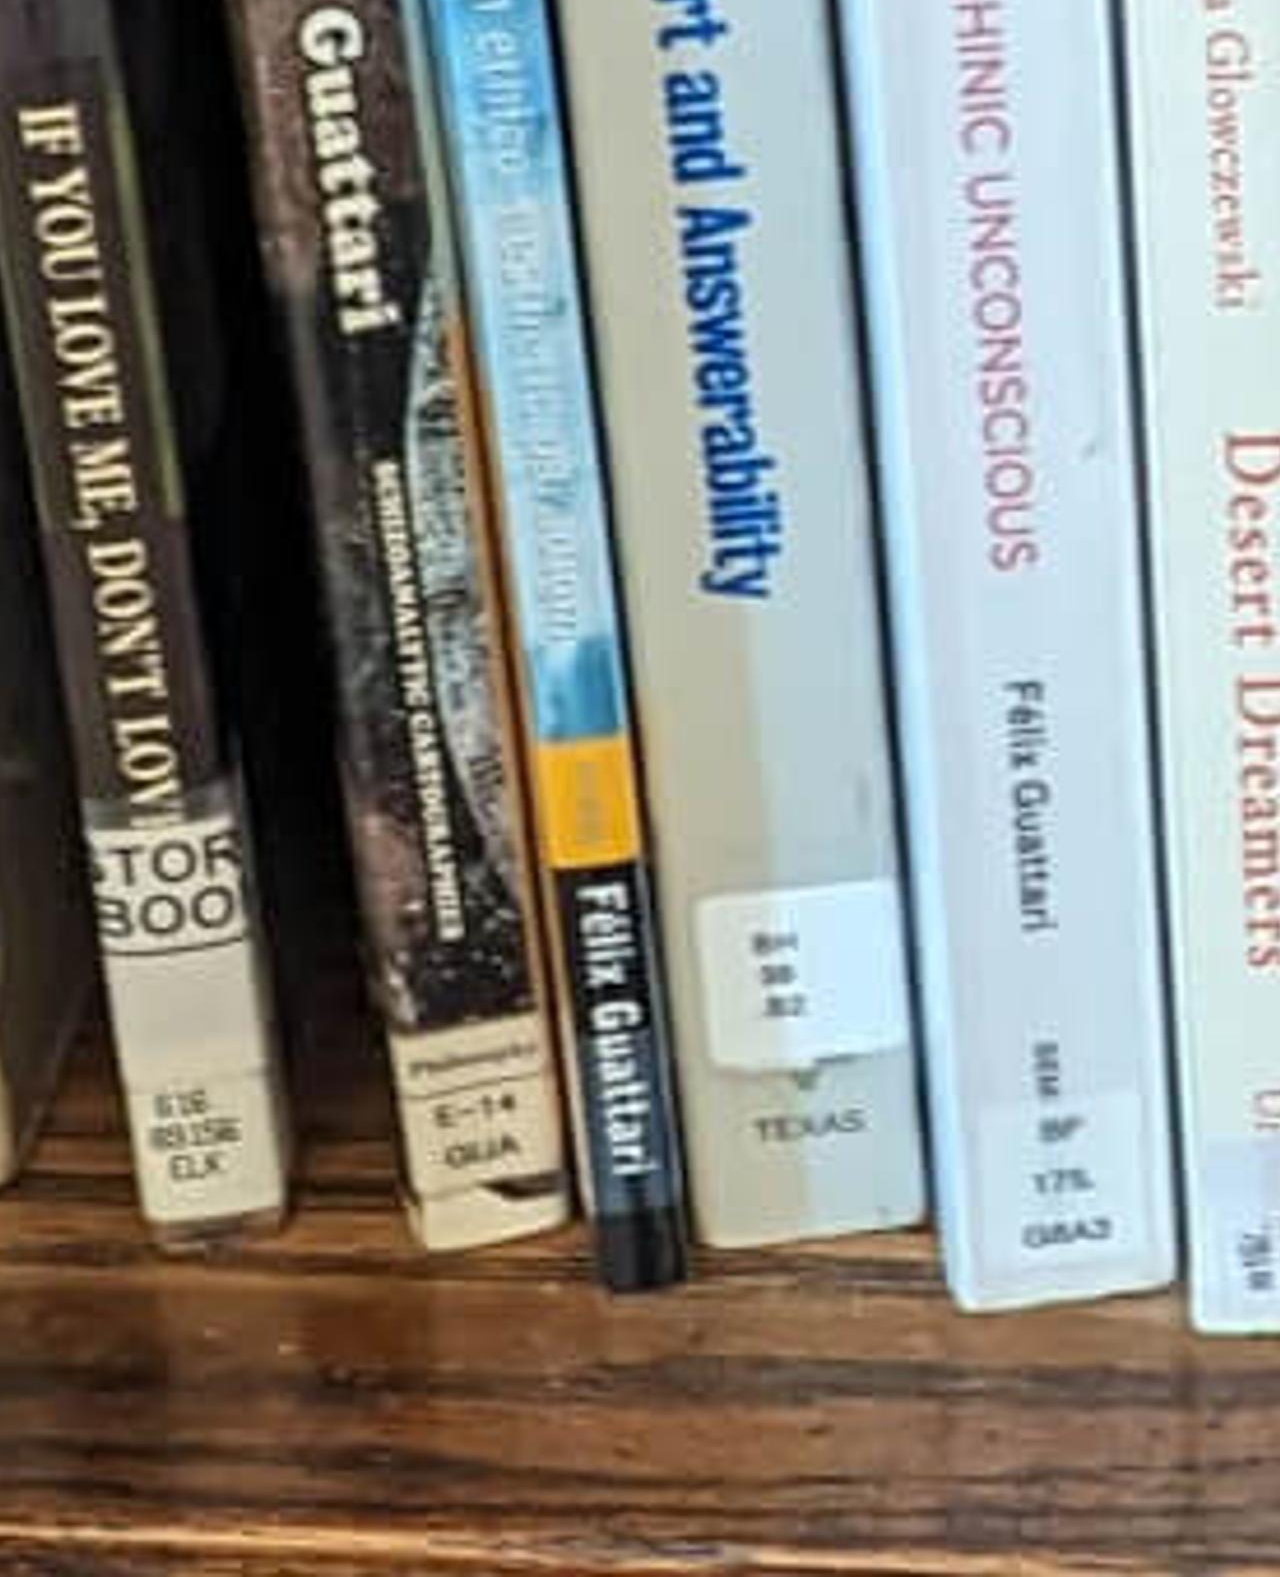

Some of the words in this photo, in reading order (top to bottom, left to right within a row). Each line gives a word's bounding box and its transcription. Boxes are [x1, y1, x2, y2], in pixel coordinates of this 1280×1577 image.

[17, 103, 86, 157] IF
[295, 5, 403, 335] Guattari
[663, 69, 744, 185] and
[1200, 27, 1264, 312] Glowczewski
[30, 166, 100, 286] YOU
[47, 299, 118, 428] LOVE
[673, 201, 783, 605] Answerability
[964, 170, 1039, 574] UNCONSCIOUS
[69, 439, 132, 533] ME,
[80, 540, 166, 701] DON'T
[368, 461, 438, 709] SCHIZOANALYTIC
[118, 714, 183, 826] LOV
[998, 678, 1052, 772] Félix
[402, 711, 470, 943] CARTOGRAPHIES
[1008, 779, 1062, 934] Guattari
[574, 878, 634, 991] Félix
[588, 1000, 662, 1178] Guattari
[752, 1107, 867, 1142] TEXAS
